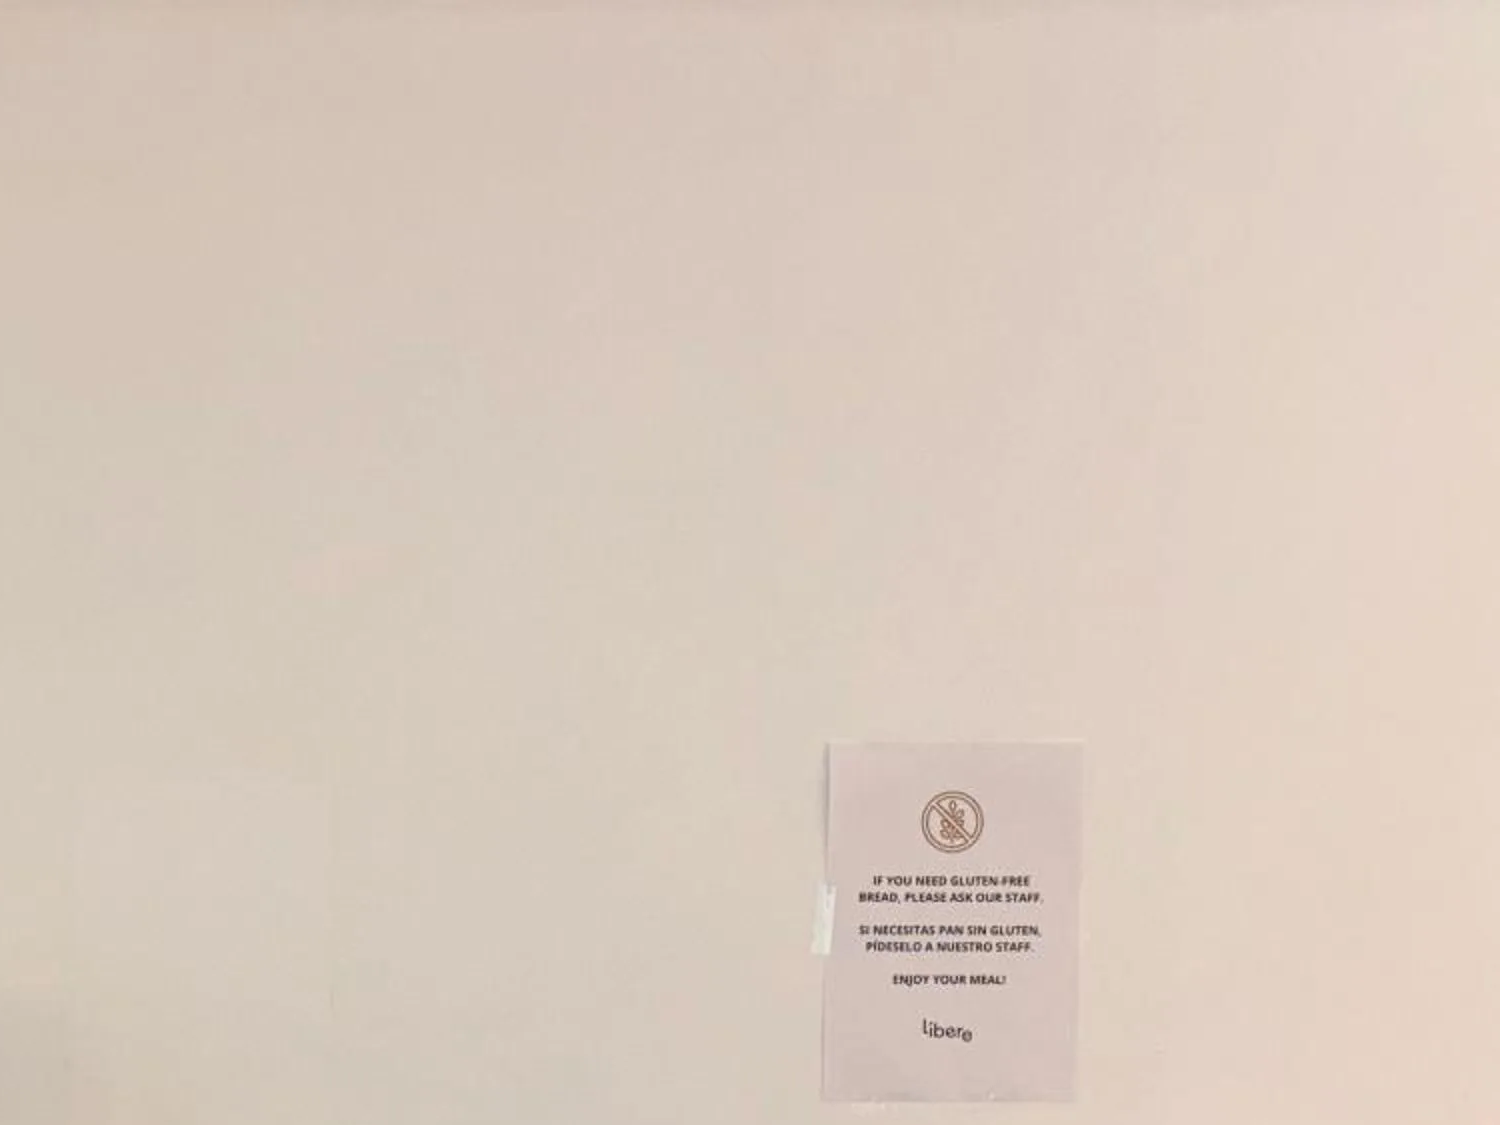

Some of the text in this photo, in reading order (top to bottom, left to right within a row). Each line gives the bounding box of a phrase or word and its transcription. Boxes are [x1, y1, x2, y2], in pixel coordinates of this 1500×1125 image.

[873, 875, 1030, 886] IF YOU NEED GLUTEN-FREE
[858, 892, 901, 904] BREAD,
[904, 892, 947, 903] PLEASE
[950, 892, 973, 903] ASK
[975, 892, 1003, 903] OUR
[859, 925, 1041, 937] SI NECESITAS PAN SIN GLUTEN,
[866, 940, 922, 952] PÍDESELO
[925, 942, 933, 952] A
[936, 942, 993, 952] NUESTRO
[892, 974, 1007, 987] ENJOY YOUR MEAL!
